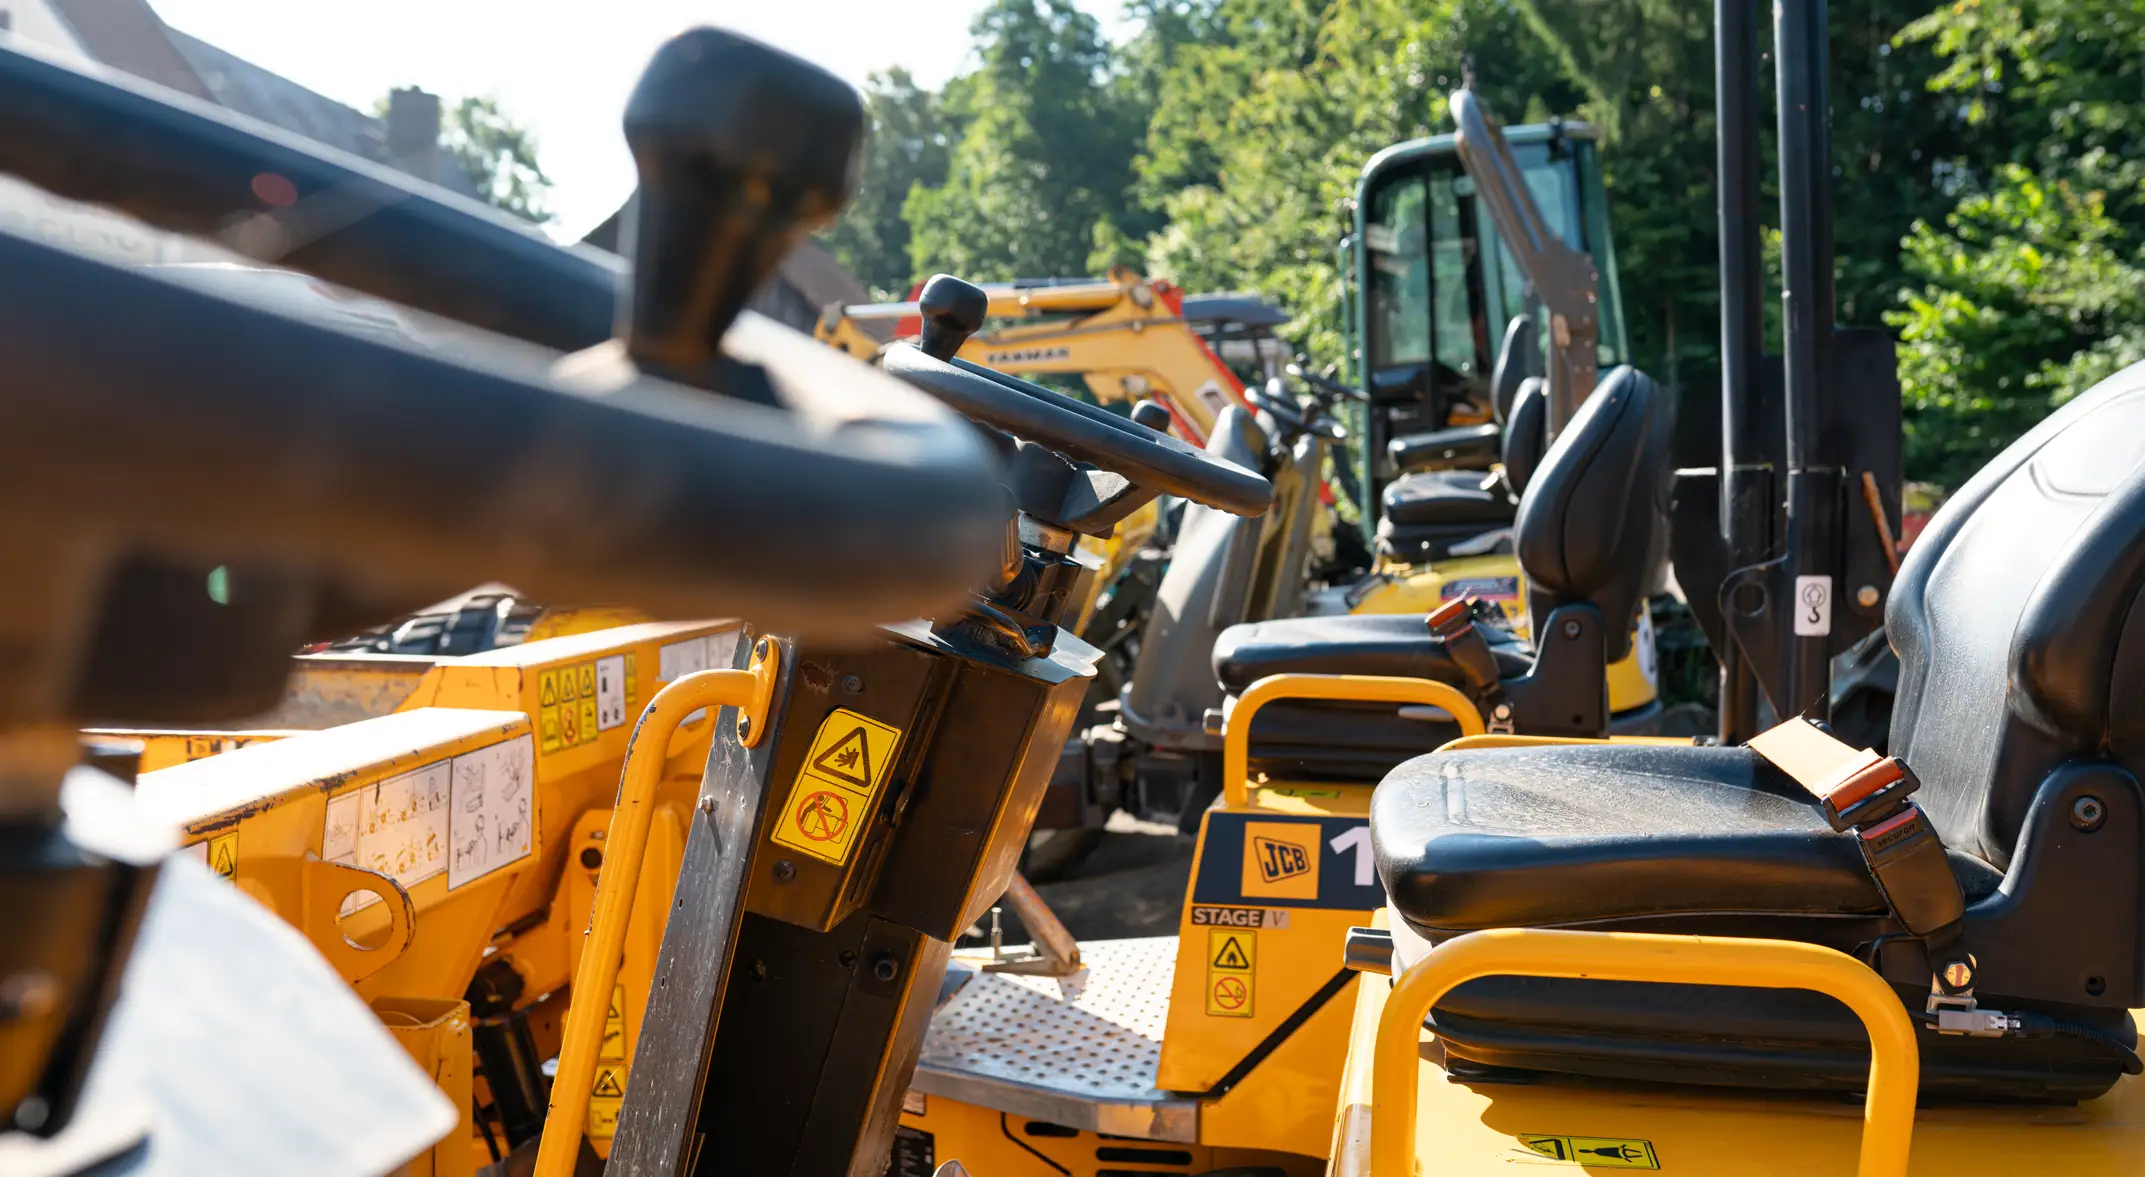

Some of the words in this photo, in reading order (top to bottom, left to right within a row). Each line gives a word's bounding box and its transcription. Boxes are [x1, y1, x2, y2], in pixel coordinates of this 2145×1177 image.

[1263, 842, 1306, 878] JCB
[1193, 907, 1261, 926] STAGE
[1271, 911, 1286, 928] V
